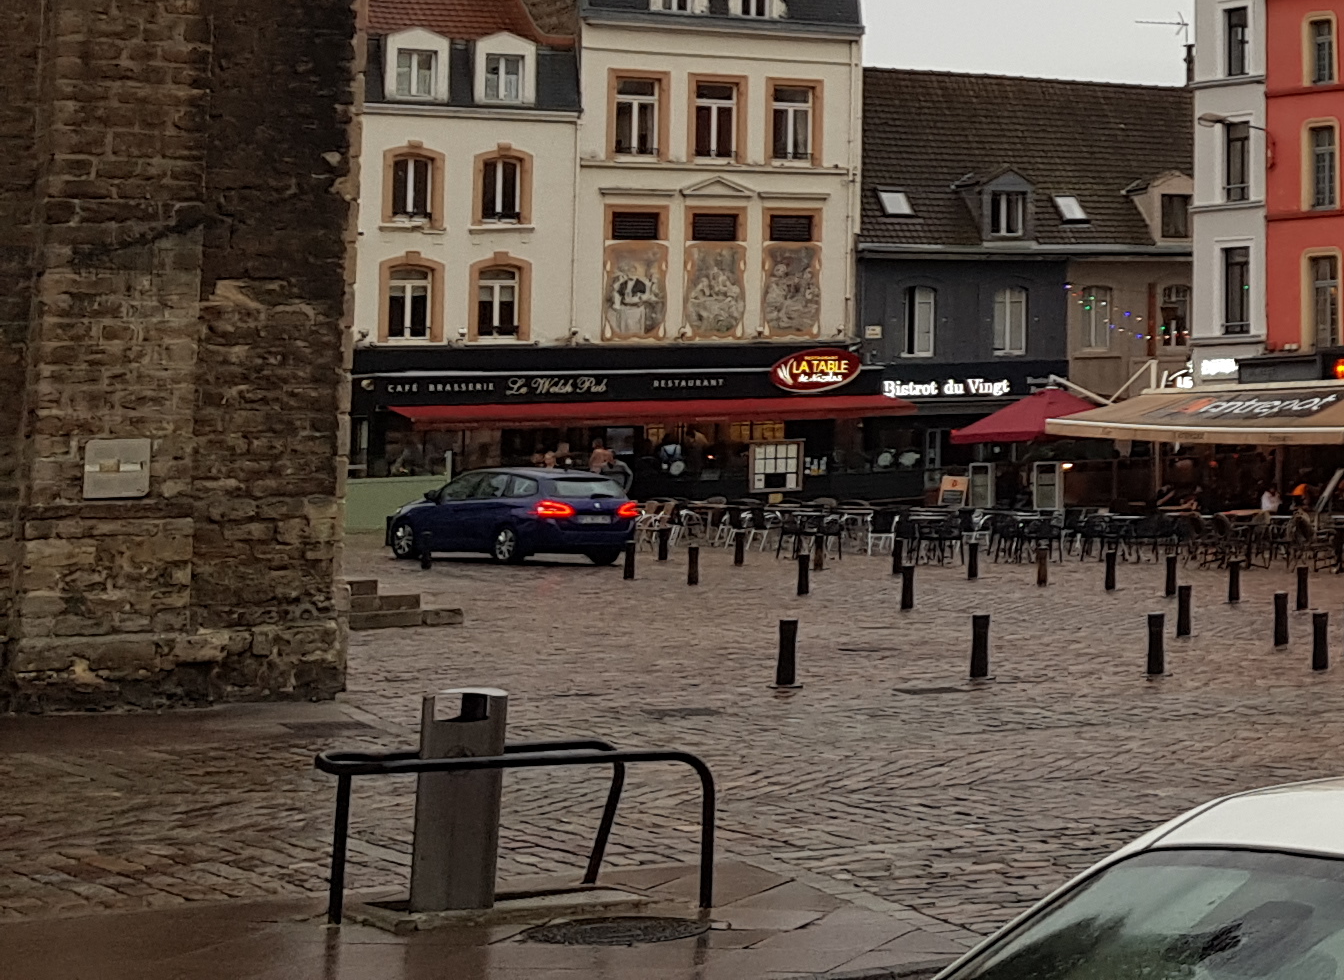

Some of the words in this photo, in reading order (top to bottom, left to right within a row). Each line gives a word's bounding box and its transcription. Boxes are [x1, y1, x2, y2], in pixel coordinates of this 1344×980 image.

[792, 360, 811, 373] LA
[811, 360, 849, 373] TABLE
[387, 382, 418, 393] CAFÉ
[428, 382, 495, 392] BRASSERIE
[506, 377, 528, 396] Le
[531, 377, 574, 395] Welsh
[576, 376, 608, 394] Pub
[653, 378, 724, 388] RESTAURANT
[882, 380, 938, 398] Bistrot
[943, 379, 965, 394] du
[967, 378, 1010, 396] Vingt
